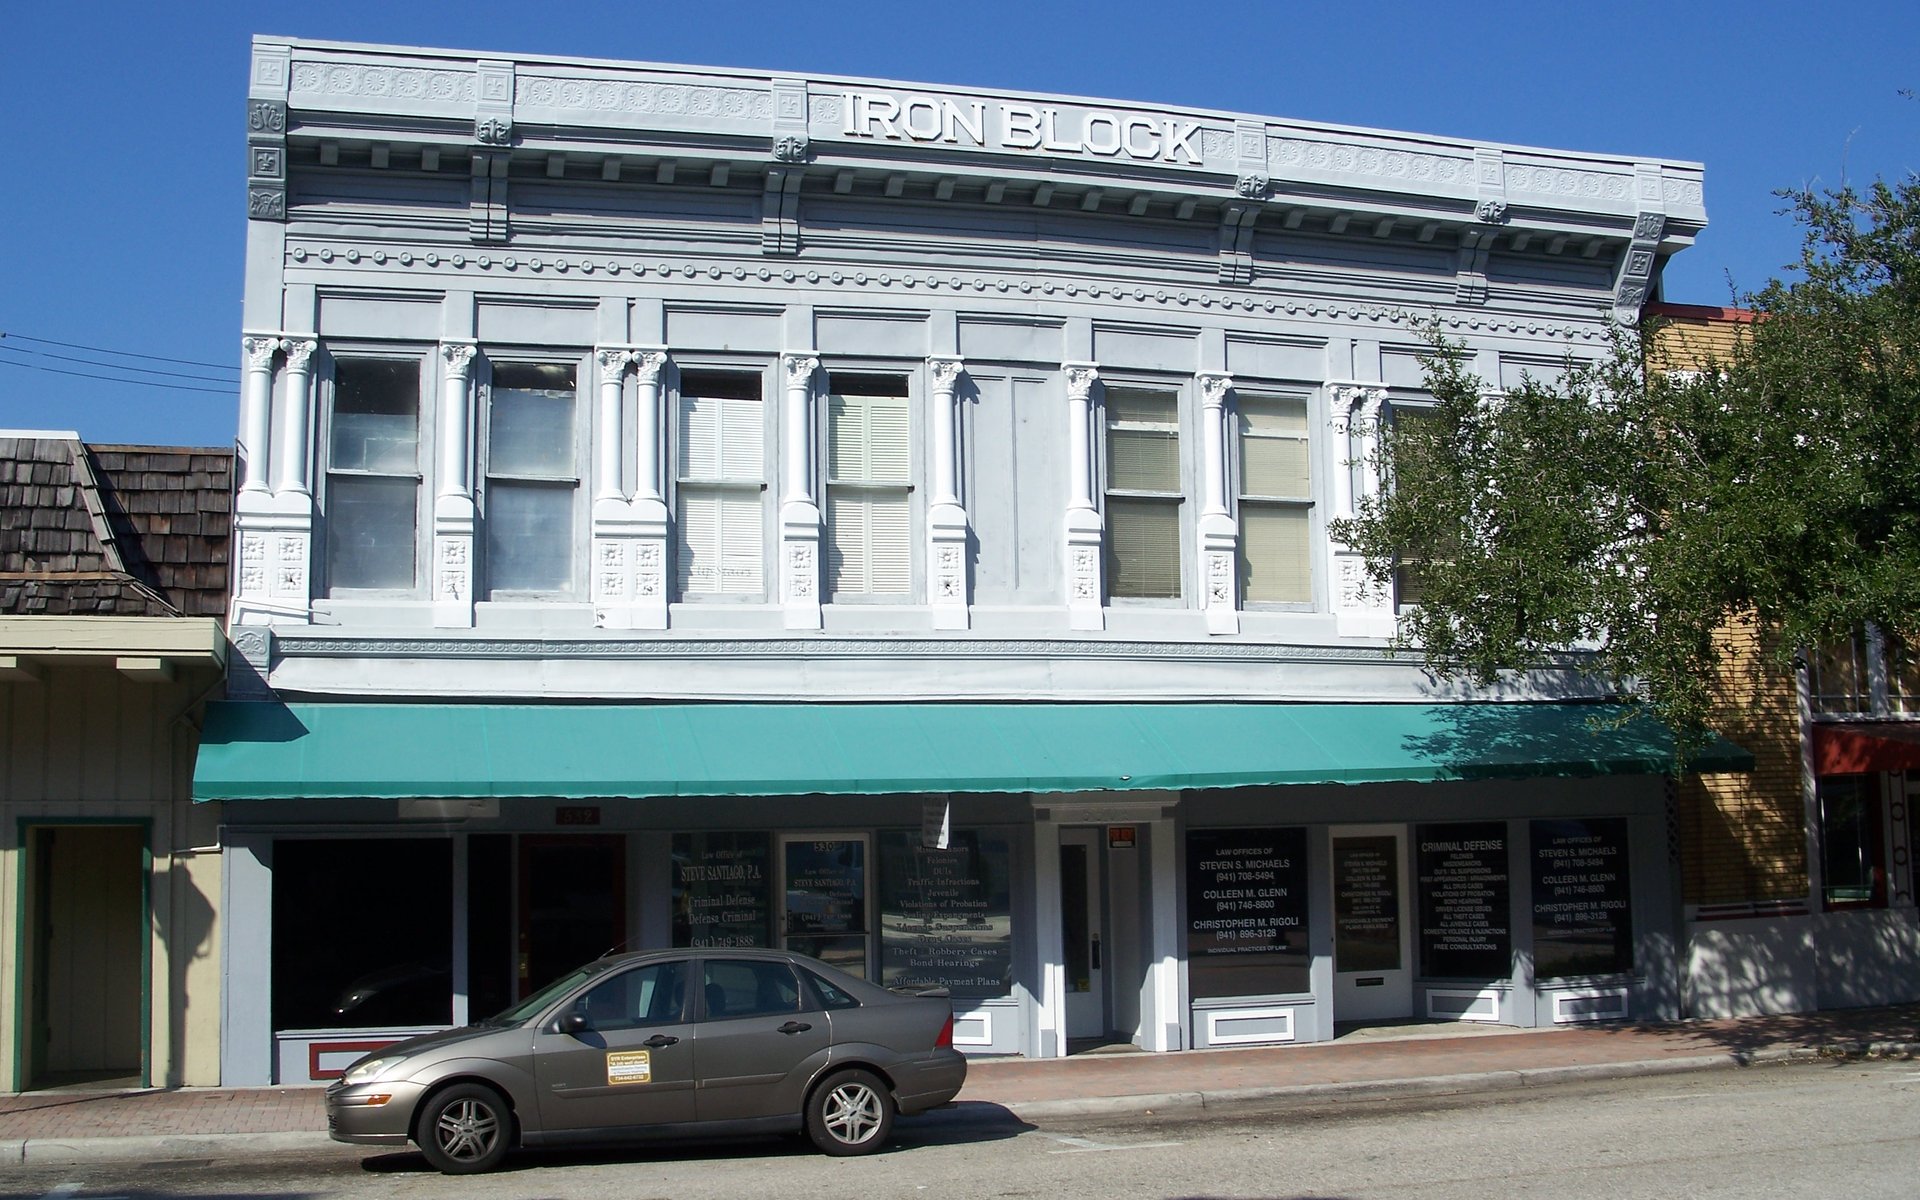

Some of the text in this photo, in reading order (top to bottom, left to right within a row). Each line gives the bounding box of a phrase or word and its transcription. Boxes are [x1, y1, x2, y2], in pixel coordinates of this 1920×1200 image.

[842, 91, 1203, 164] IRON BLOCK
[815, 842, 834, 852] 530
[1421, 840, 1503, 852] CRIMINAL DEFENSE
[1232, 848, 1263, 856] OFFICES
[1538, 847, 1617, 858] STEVEN S. MICHAELS
[1200, 859, 1290, 870] STEVEN S. MICHAELS
[1553, 860, 1571, 869] (941)
[682, 866, 706, 882] STEVE
[1216, 871, 1274, 882] (941) 708-5494
[1542, 873, 1616, 885] COLLEEN M. GLENN
[937, 878, 980, 886] Infractions
[927, 889, 960, 897] Juvenile
[1203, 888, 1288, 899] COLLEEN M. GLENN
[1554, 886, 1572, 896] (941)
[689, 894, 756, 908] Criminal Defense
[900, 900, 937, 908] Violations
[951, 900, 988, 908] Probation
[1216, 900, 1275, 912] (941) 746-8800
[1534, 900, 1626, 912] CHRISTOPHER M. RIGOLI
[689, 910, 756, 924] Defense Criminal
[1554, 913, 1572, 923] (941)
[1193, 917, 1299, 929] CHRISTOPHER M. RIGOLI
[1216, 929, 1277, 942] (941) 896-3128
[929, 947, 967, 957] Robbery
[910, 958, 980, 967] Bond Hearings
[939, 977, 974, 986] Payment
[977, 977, 1001, 985] Plans
